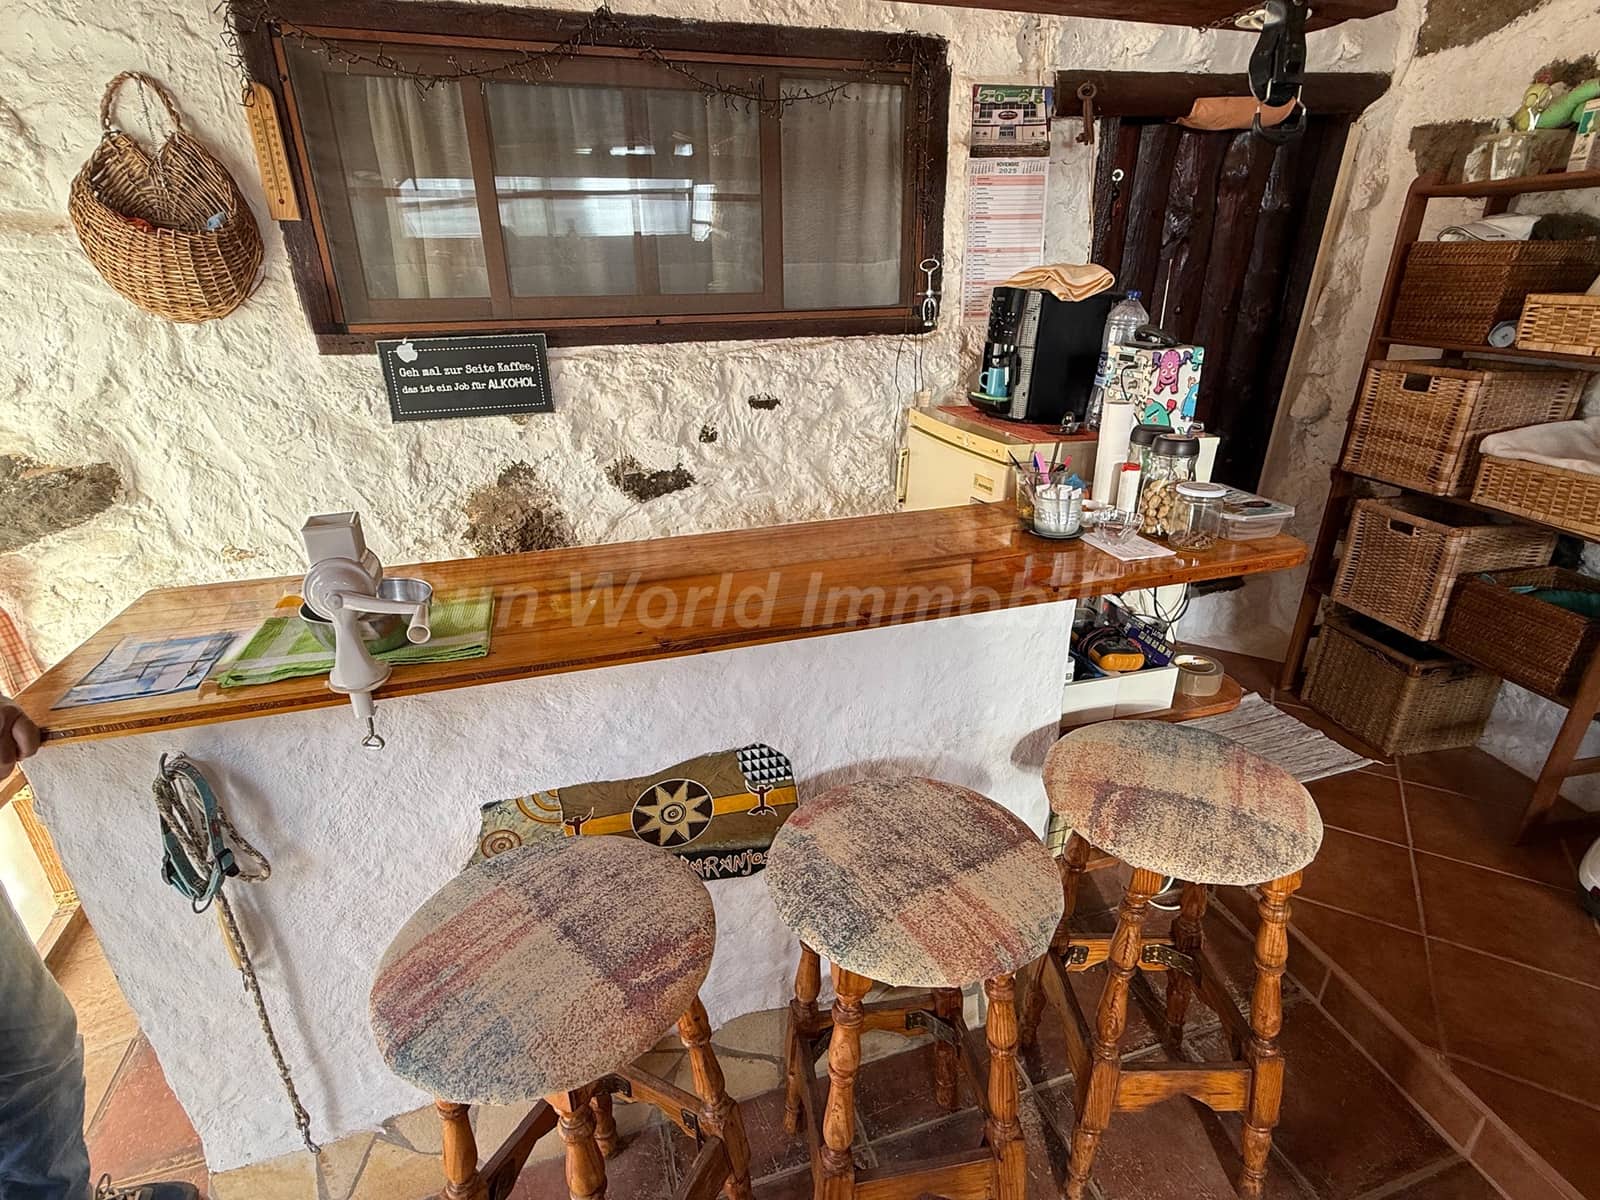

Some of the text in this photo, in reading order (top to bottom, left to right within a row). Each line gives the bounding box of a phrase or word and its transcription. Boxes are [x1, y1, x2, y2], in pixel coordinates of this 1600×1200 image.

[399, 361, 535, 378] Geh mal zur Seite Kaffee,
[402, 376, 536, 394] das ist ein Job für ALKOHOL
